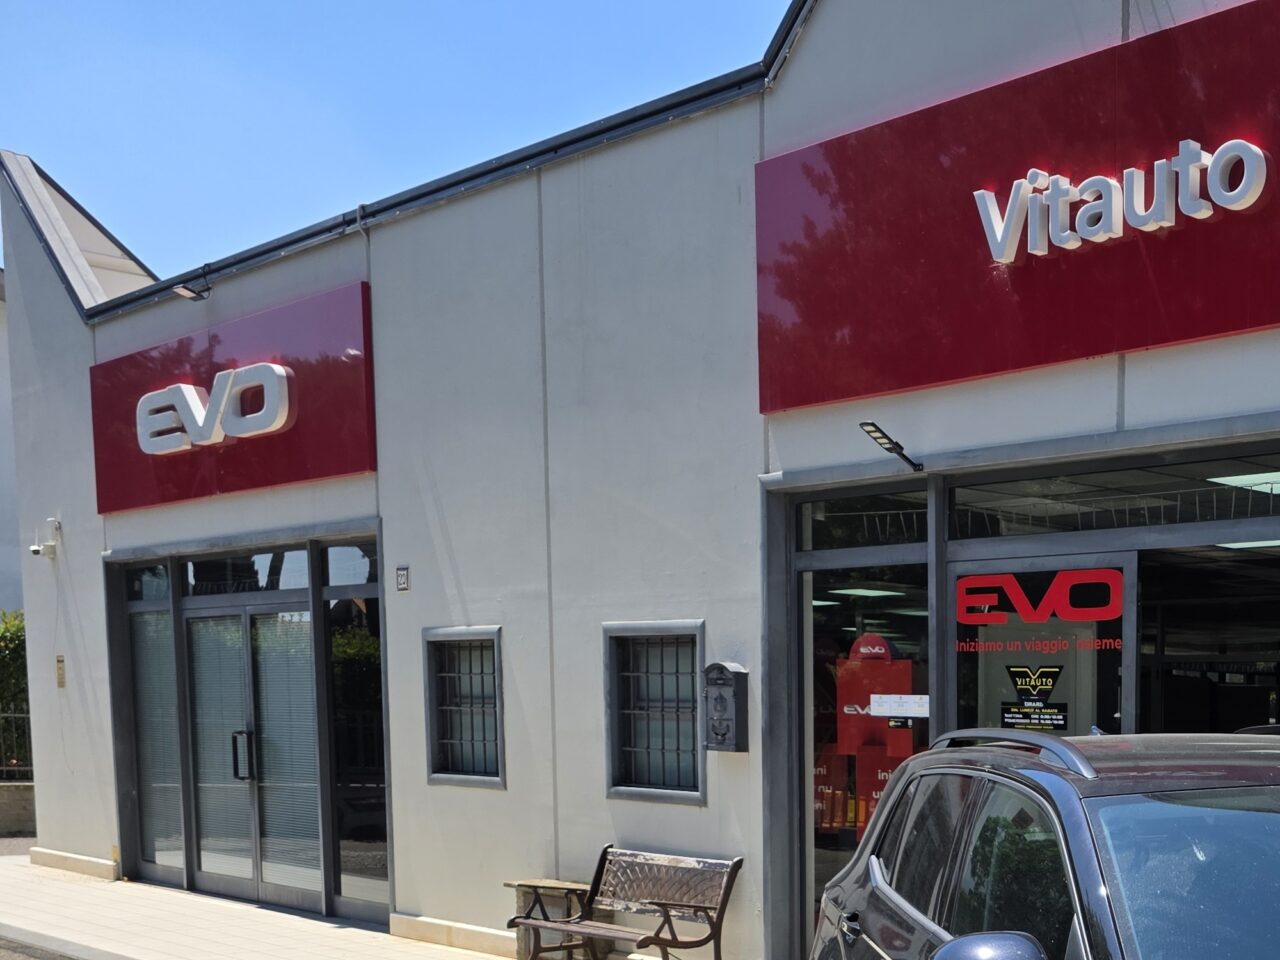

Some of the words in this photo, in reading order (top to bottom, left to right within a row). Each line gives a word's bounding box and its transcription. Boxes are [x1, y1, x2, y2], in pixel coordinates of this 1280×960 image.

[973, 139, 1267, 264] Vitauto
[136, 361, 293, 456] EVO
[956, 568, 1124, 625] EVO
[860, 646, 886, 654] EVO
[955, 637, 1004, 652] Iniziamo
[1007, 639, 1022, 652] un
[1024, 636, 1070, 654] viaggio
[1016, 677, 1053, 686] VITAUTO
